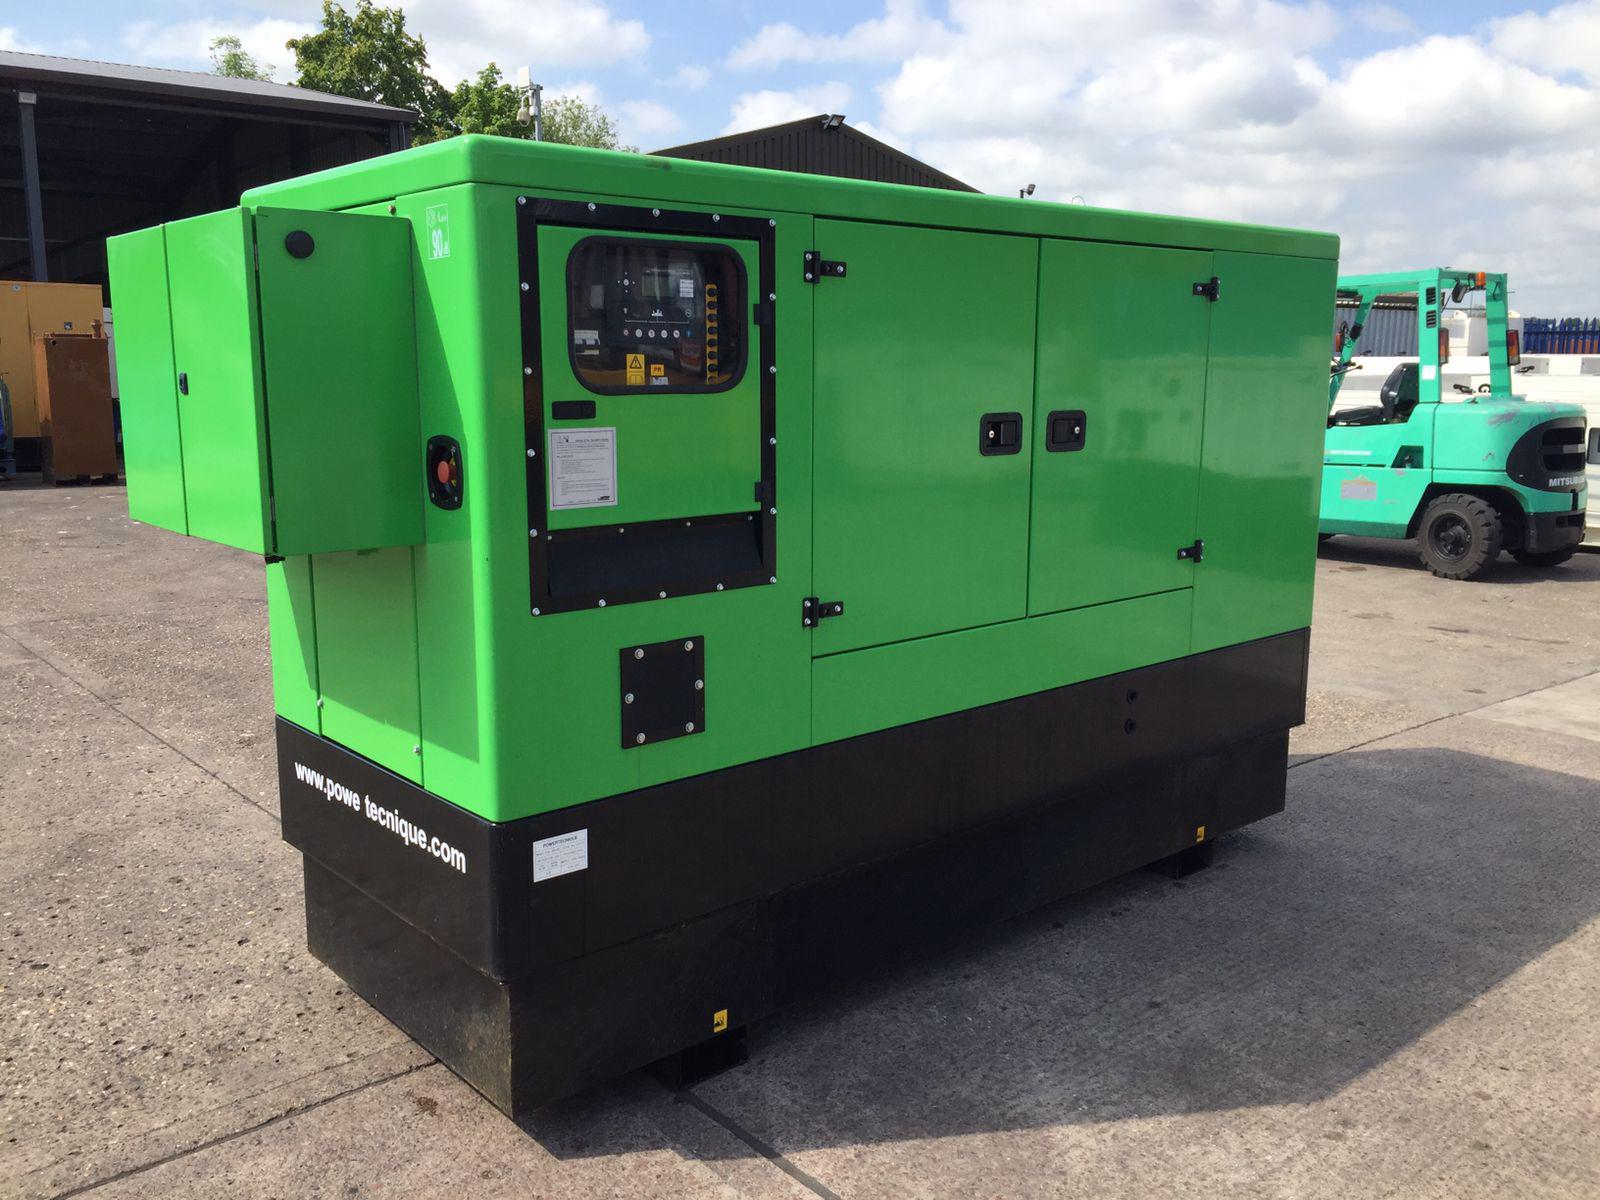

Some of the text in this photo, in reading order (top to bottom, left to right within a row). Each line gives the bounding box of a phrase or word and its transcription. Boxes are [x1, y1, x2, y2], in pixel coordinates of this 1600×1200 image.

[432, 229, 443, 257] 90
[1549, 476, 1585, 487] MITSUB
[294, 762, 361, 812] www.powe
[364, 794, 467, 874] tecnique.com
